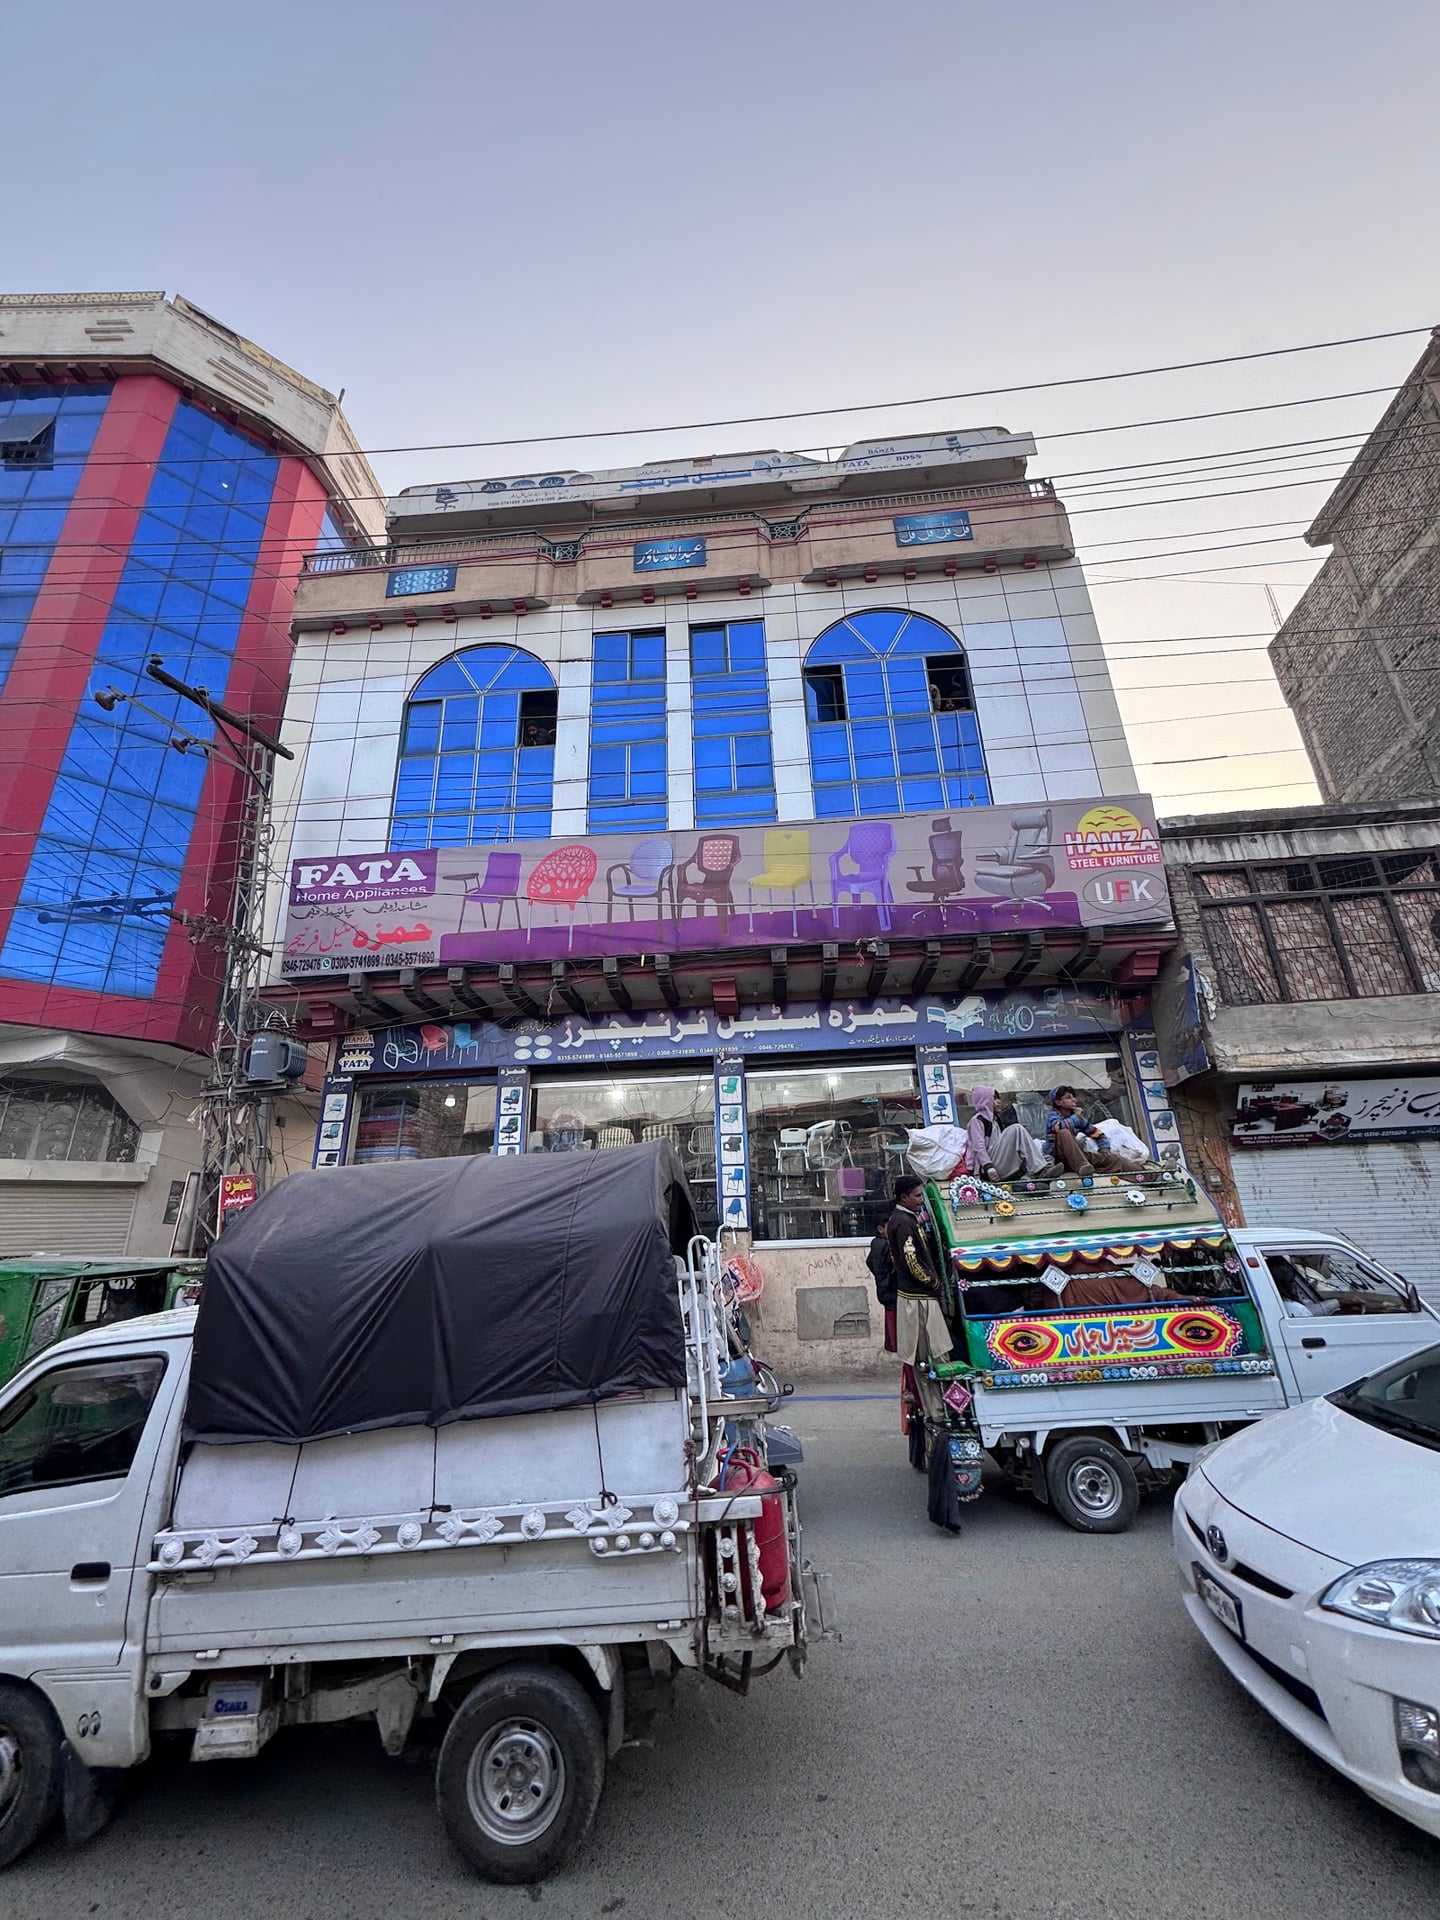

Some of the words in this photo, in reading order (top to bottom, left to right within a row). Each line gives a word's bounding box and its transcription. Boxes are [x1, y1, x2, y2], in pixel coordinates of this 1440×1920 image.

[867, 447, 895, 455] HAMZA
[842, 460, 871, 468] FATA
[1064, 828, 1158, 855] HAMZA
[1070, 858, 1101, 869] STEEL
[1103, 853, 1160, 866] FURNITURE
[296, 858, 427, 888] FATA
[296, 891, 340, 903] Home
[343, 885, 427, 901] Appliances
[1094, 879, 1154, 904] UFK
[352, 922, 433, 951] حمزہ
[331, 954, 380, 970] 0300-5741899
[716, 1003, 821, 1040] سٹیل
[828, 1004, 919, 1033] حمزہ
[344, 1035, 374, 1043] HAMZA
[343, 1059, 369, 1068] FATA
[225, 1178, 253, 1196] حمزہ
